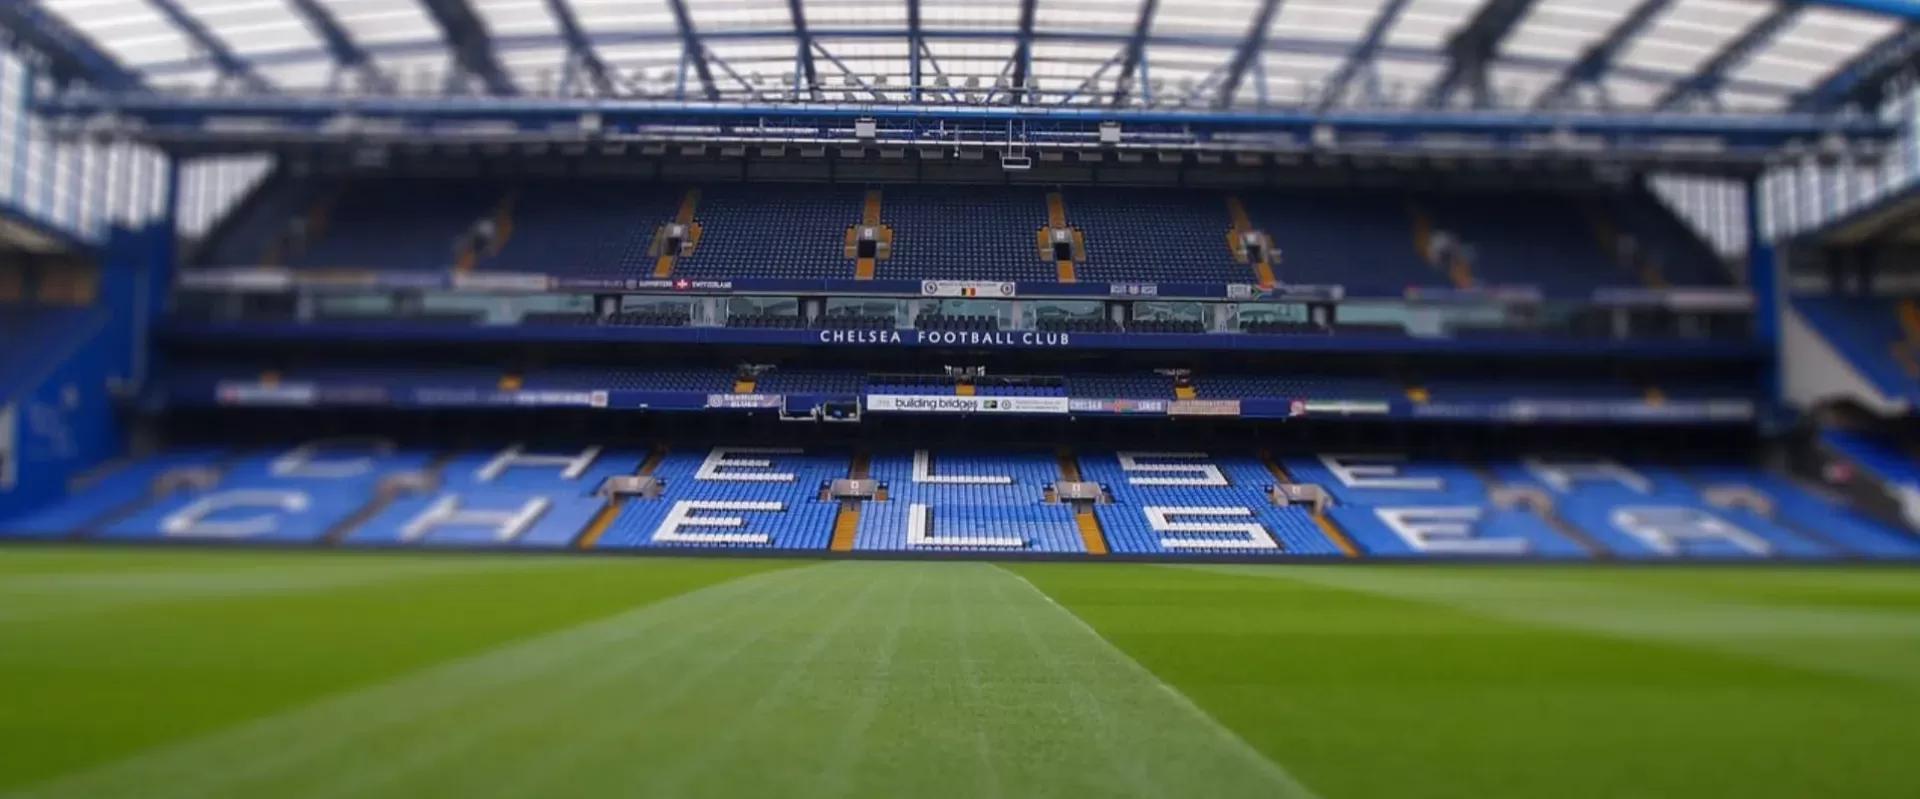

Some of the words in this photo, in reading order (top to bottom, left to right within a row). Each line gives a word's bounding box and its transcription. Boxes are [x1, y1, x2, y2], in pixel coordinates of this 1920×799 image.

[820, 329, 902, 344] CHELSEA
[918, 331, 1015, 346] FOOTBALL
[1023, 332, 1069, 346] CLUB
[895, 397, 937, 410] building
[938, 398, 979, 411] bridges
[160, 489, 1771, 558] CHELSEA
